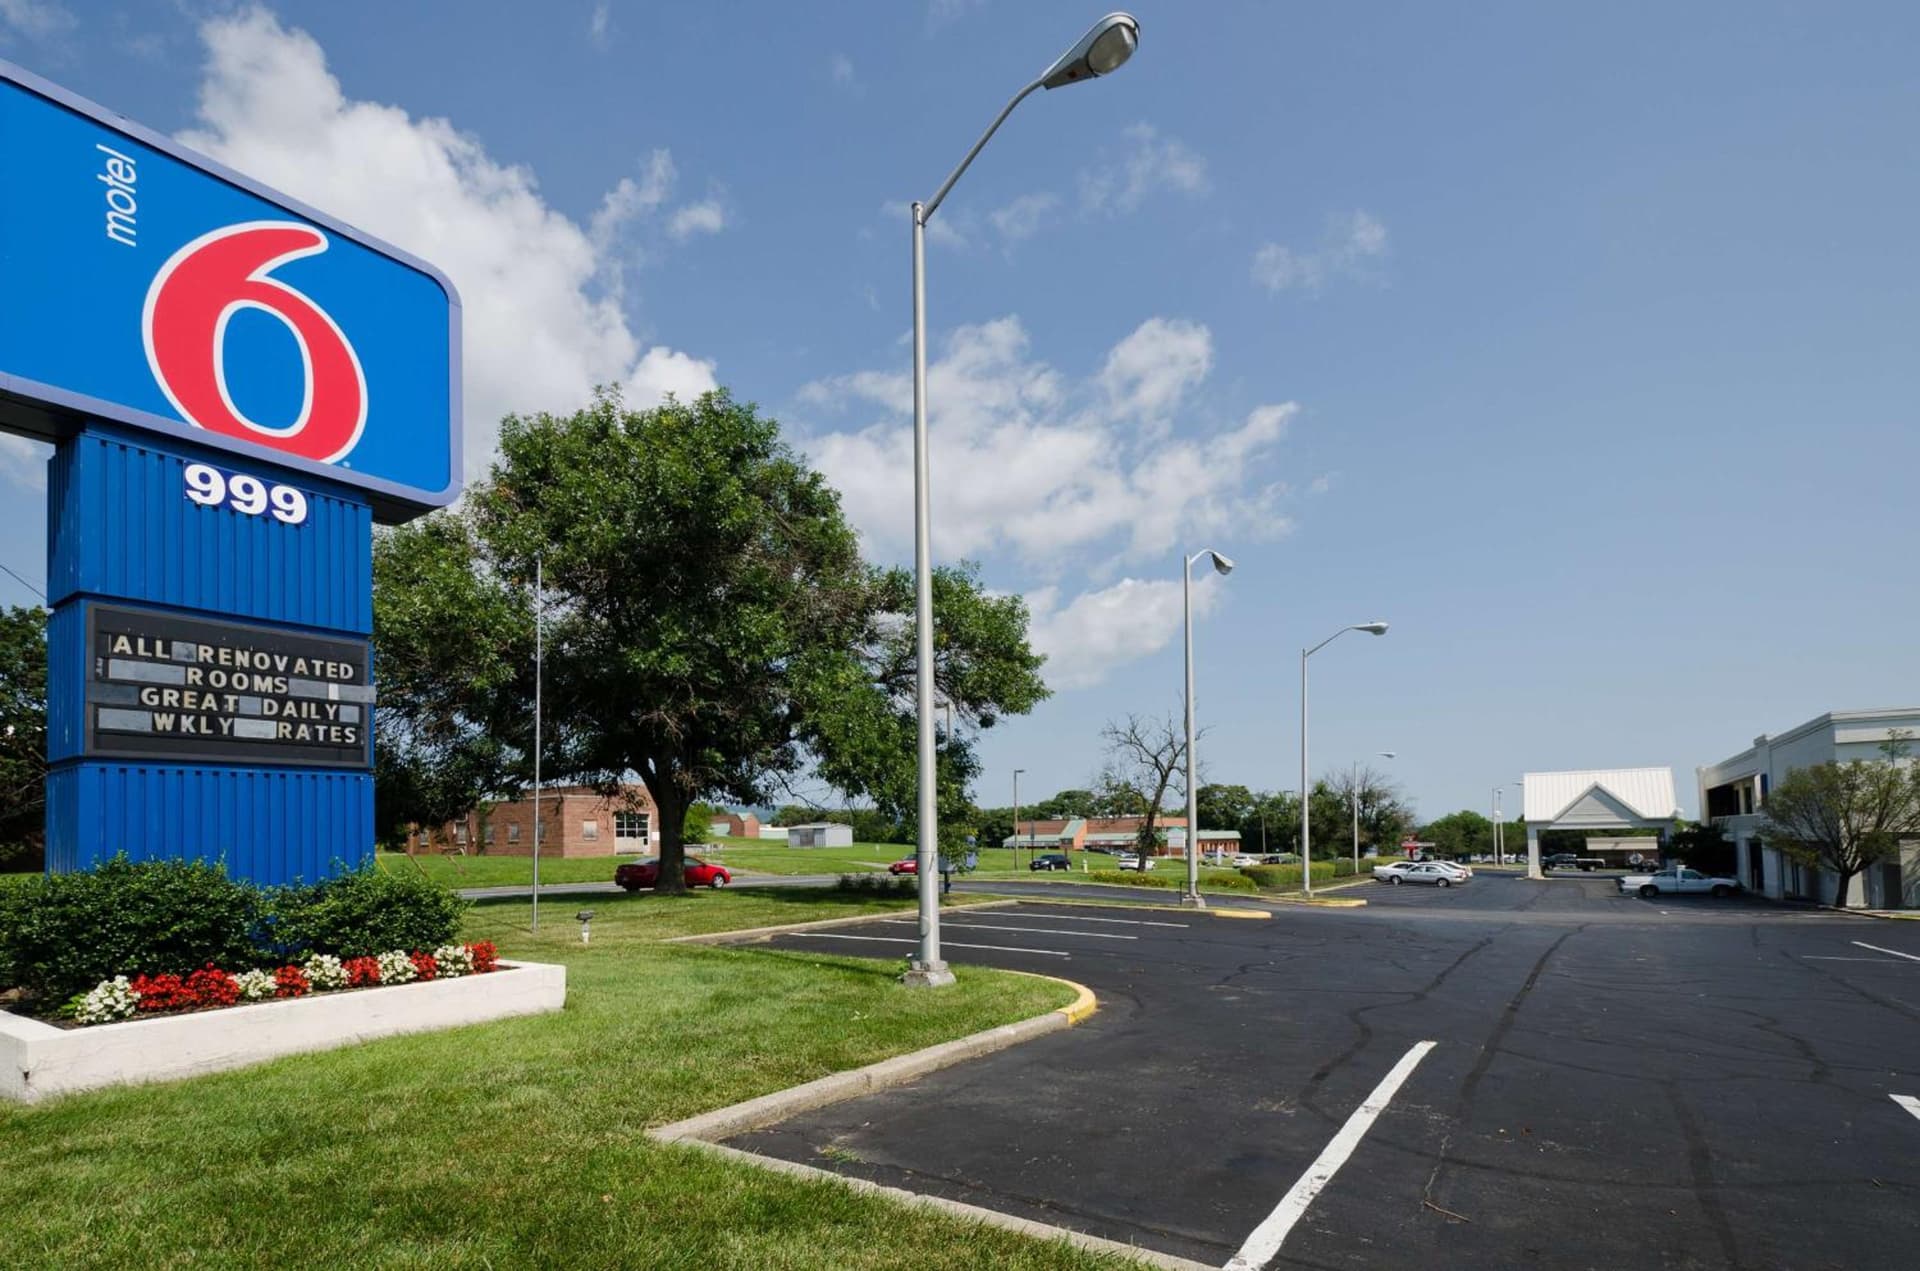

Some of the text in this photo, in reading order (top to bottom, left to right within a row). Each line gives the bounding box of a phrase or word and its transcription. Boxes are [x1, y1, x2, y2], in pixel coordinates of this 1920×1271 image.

[96, 144, 137, 247] motel
[142, 220, 368, 465] 6
[184, 464, 308, 525] 999
[113, 635, 354, 679] ALL RENOVATED
[187, 667, 288, 694] ROOMS
[141, 687, 338, 720] GREAT DAILY
[153, 712, 356, 744] WKLY RATES
